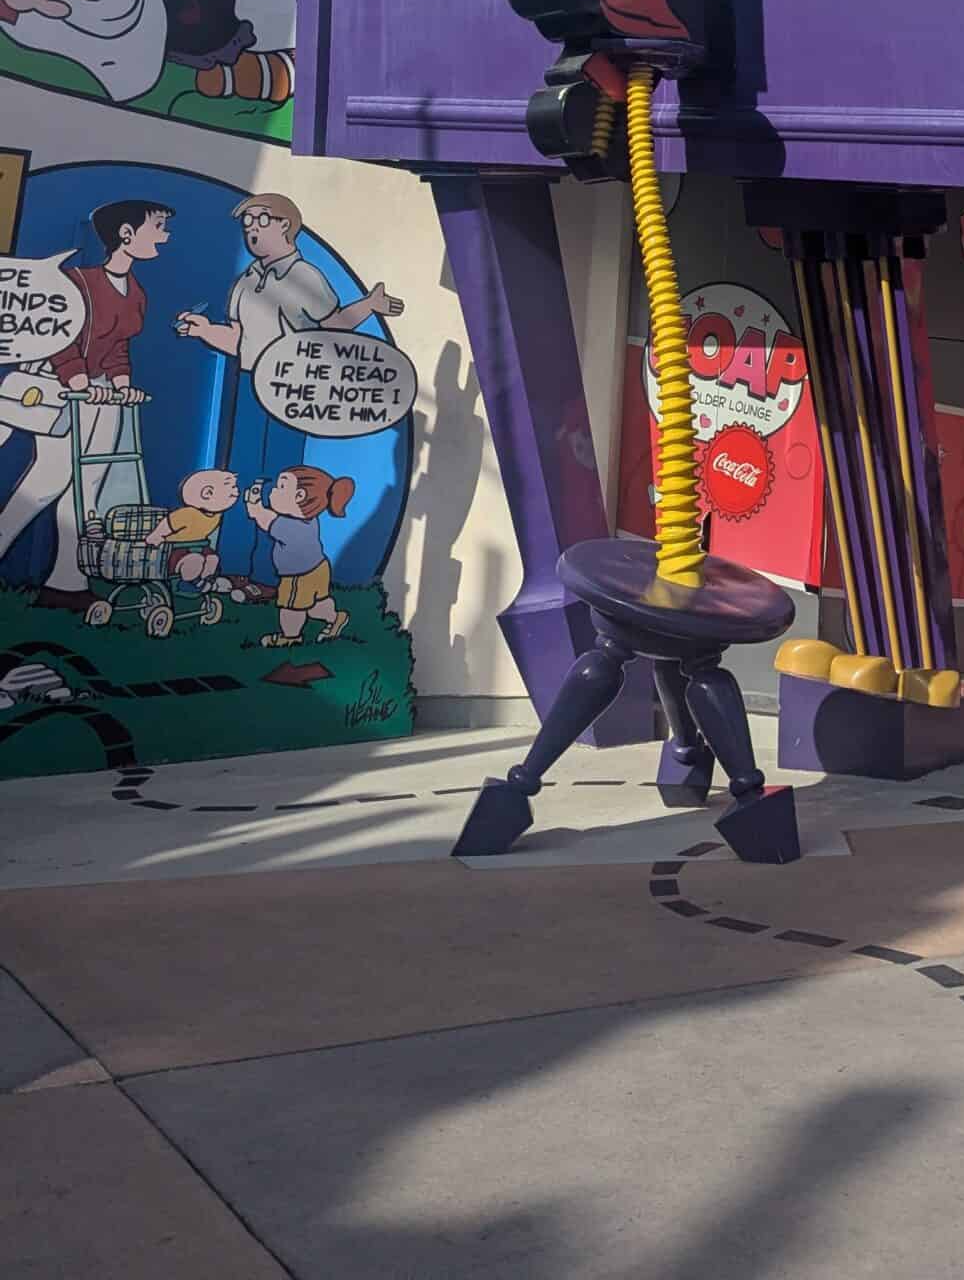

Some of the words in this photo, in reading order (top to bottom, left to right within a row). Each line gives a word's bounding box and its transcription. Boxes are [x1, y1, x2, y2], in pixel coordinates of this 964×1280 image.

[0, 290, 68, 313] INDS
[0, 313, 73, 338] BACK
[296, 341, 324, 360] HE
[334, 342, 384, 362] WILL
[275, 361, 294, 378] IF
[305, 363, 331, 380] HE
[341, 365, 397, 384] READ
[270, 381, 316, 401] THE
[329, 385, 384, 403] NOTE
[391, 388, 400, 404] I
[284, 402, 341, 421] GAVE
[349, 406, 393, 422] HIM.
[729, 400, 773, 422] LOUNGE
[712, 452, 762, 488] Coca-Cola
